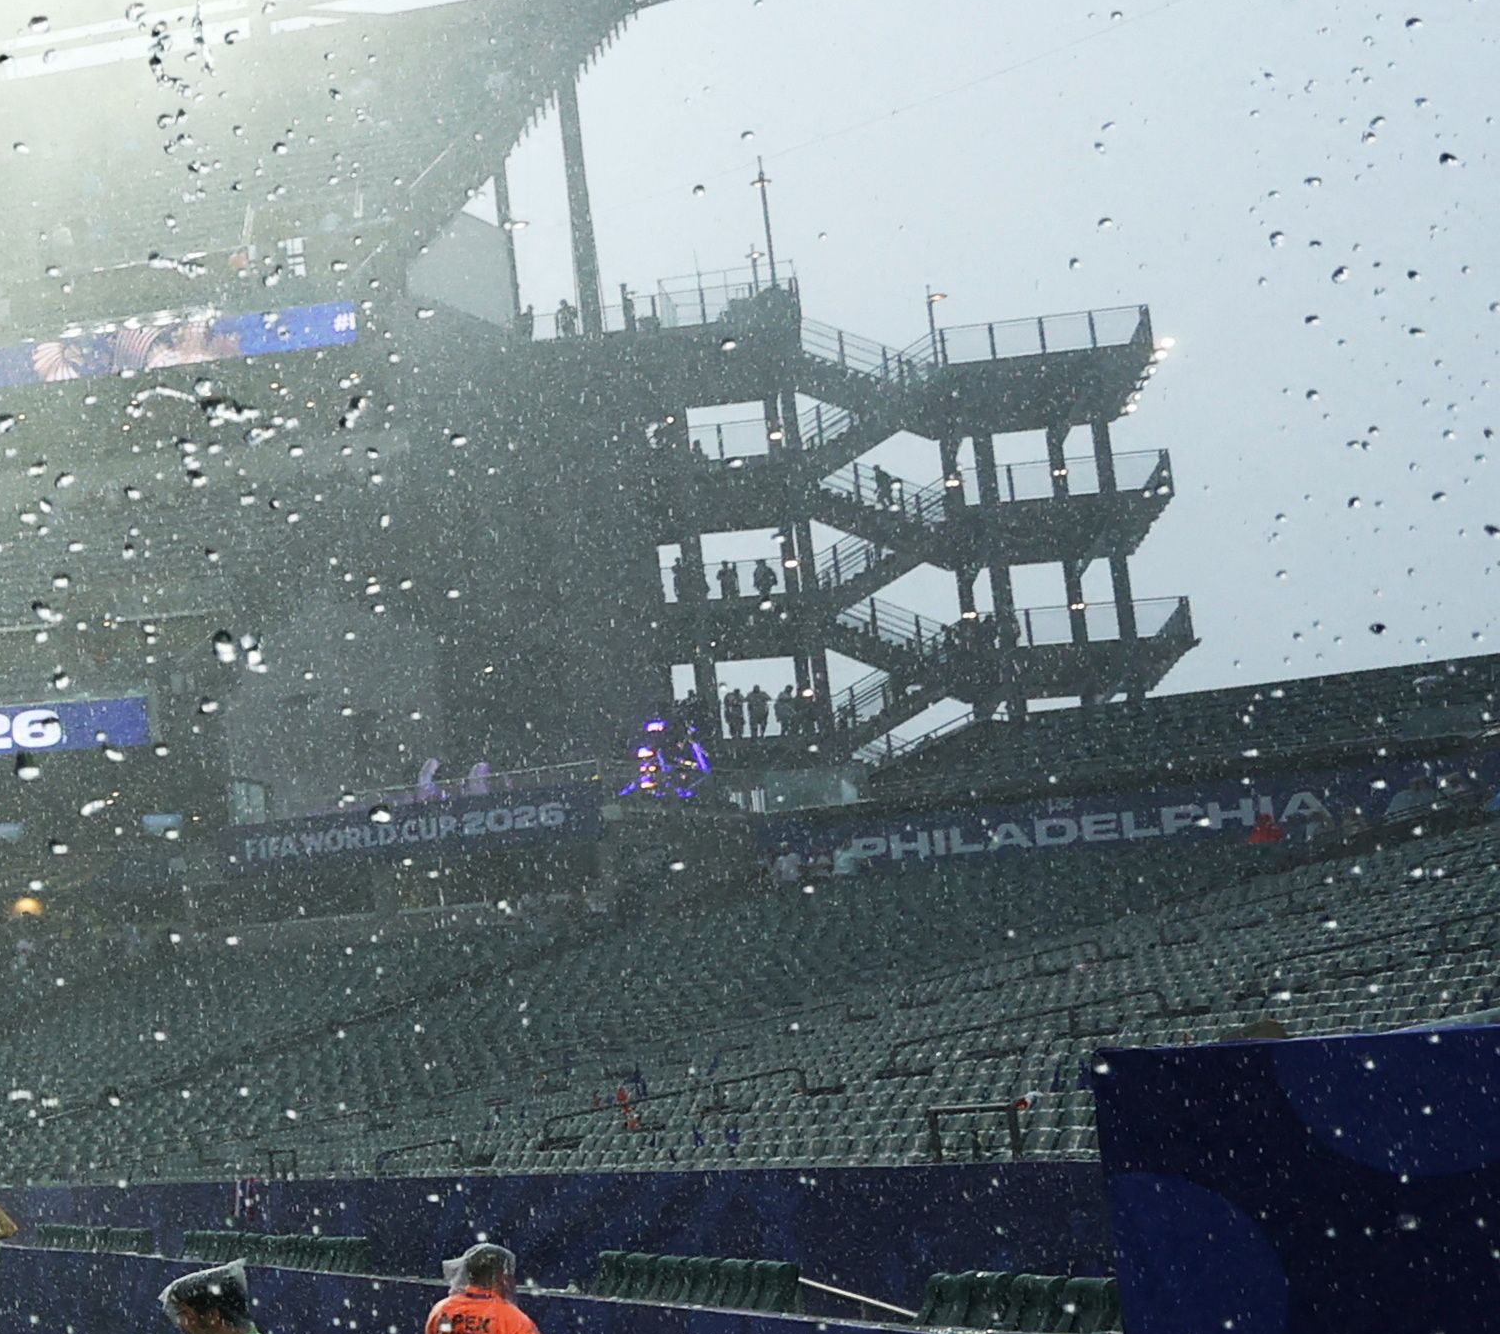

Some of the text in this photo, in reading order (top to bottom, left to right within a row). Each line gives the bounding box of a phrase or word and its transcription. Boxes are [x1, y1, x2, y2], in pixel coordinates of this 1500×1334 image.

[245, 802, 566, 861] FIFA WORLD CUP 2026
[850, 791, 1334, 861] PHILADELPHIA
